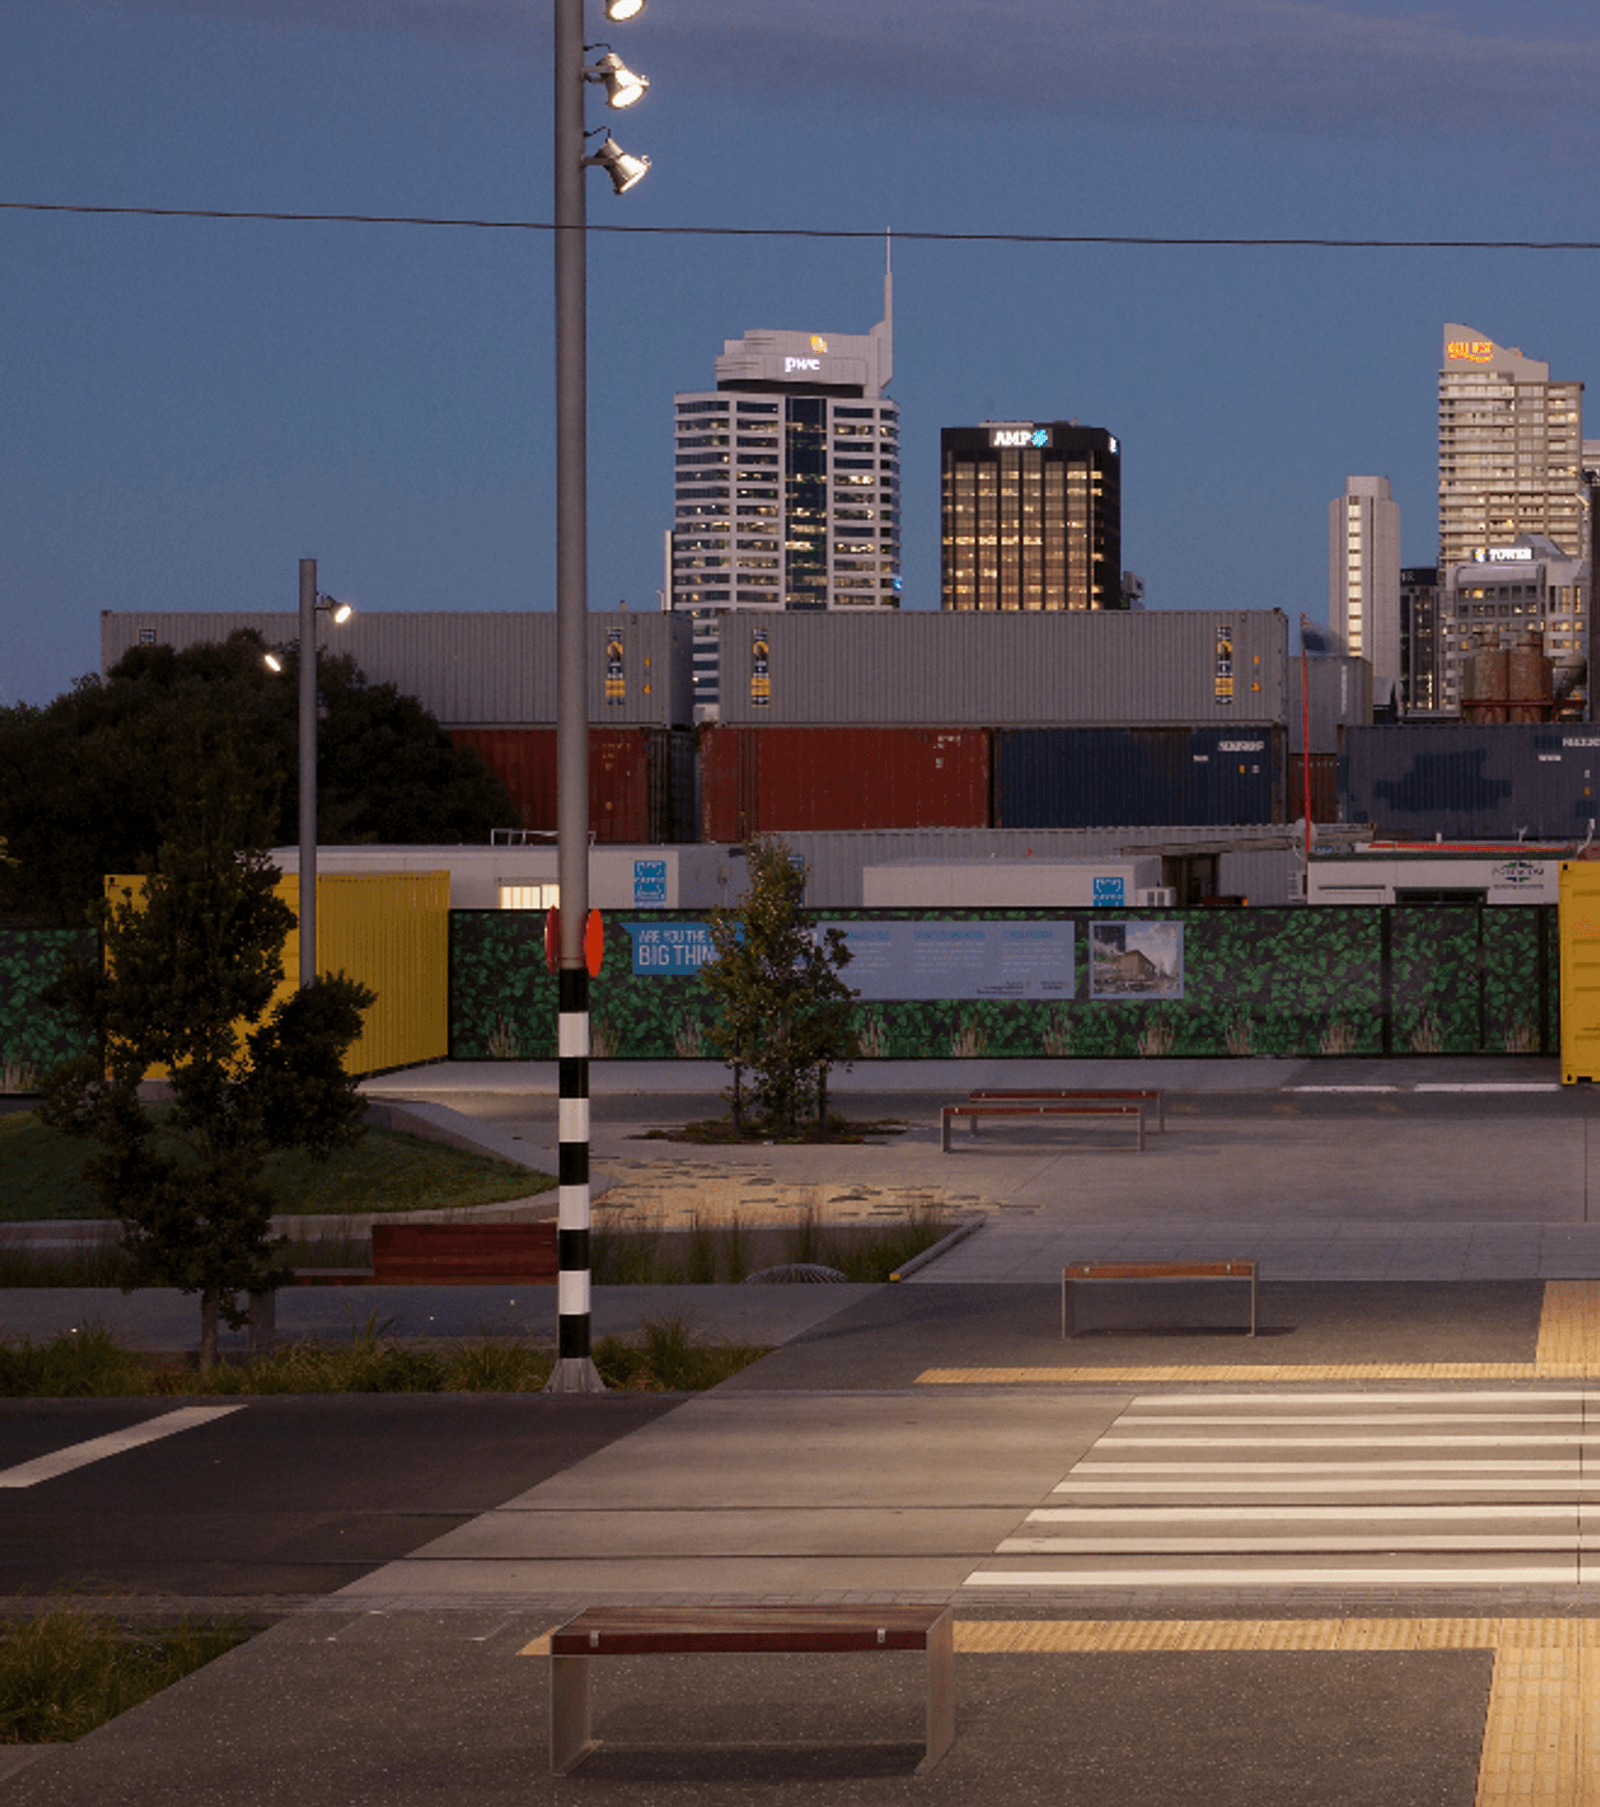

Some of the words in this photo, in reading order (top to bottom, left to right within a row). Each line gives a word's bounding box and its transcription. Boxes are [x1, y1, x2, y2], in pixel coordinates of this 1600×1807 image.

[785, 356, 820, 373] pwc
[994, 430, 1031, 446] AMP
[638, 929, 660, 944] ARE
[663, 929, 684, 944] YOU
[685, 929, 706, 944] THE
[638, 945, 670, 966] BIG
[673, 945, 717, 966] THIN
